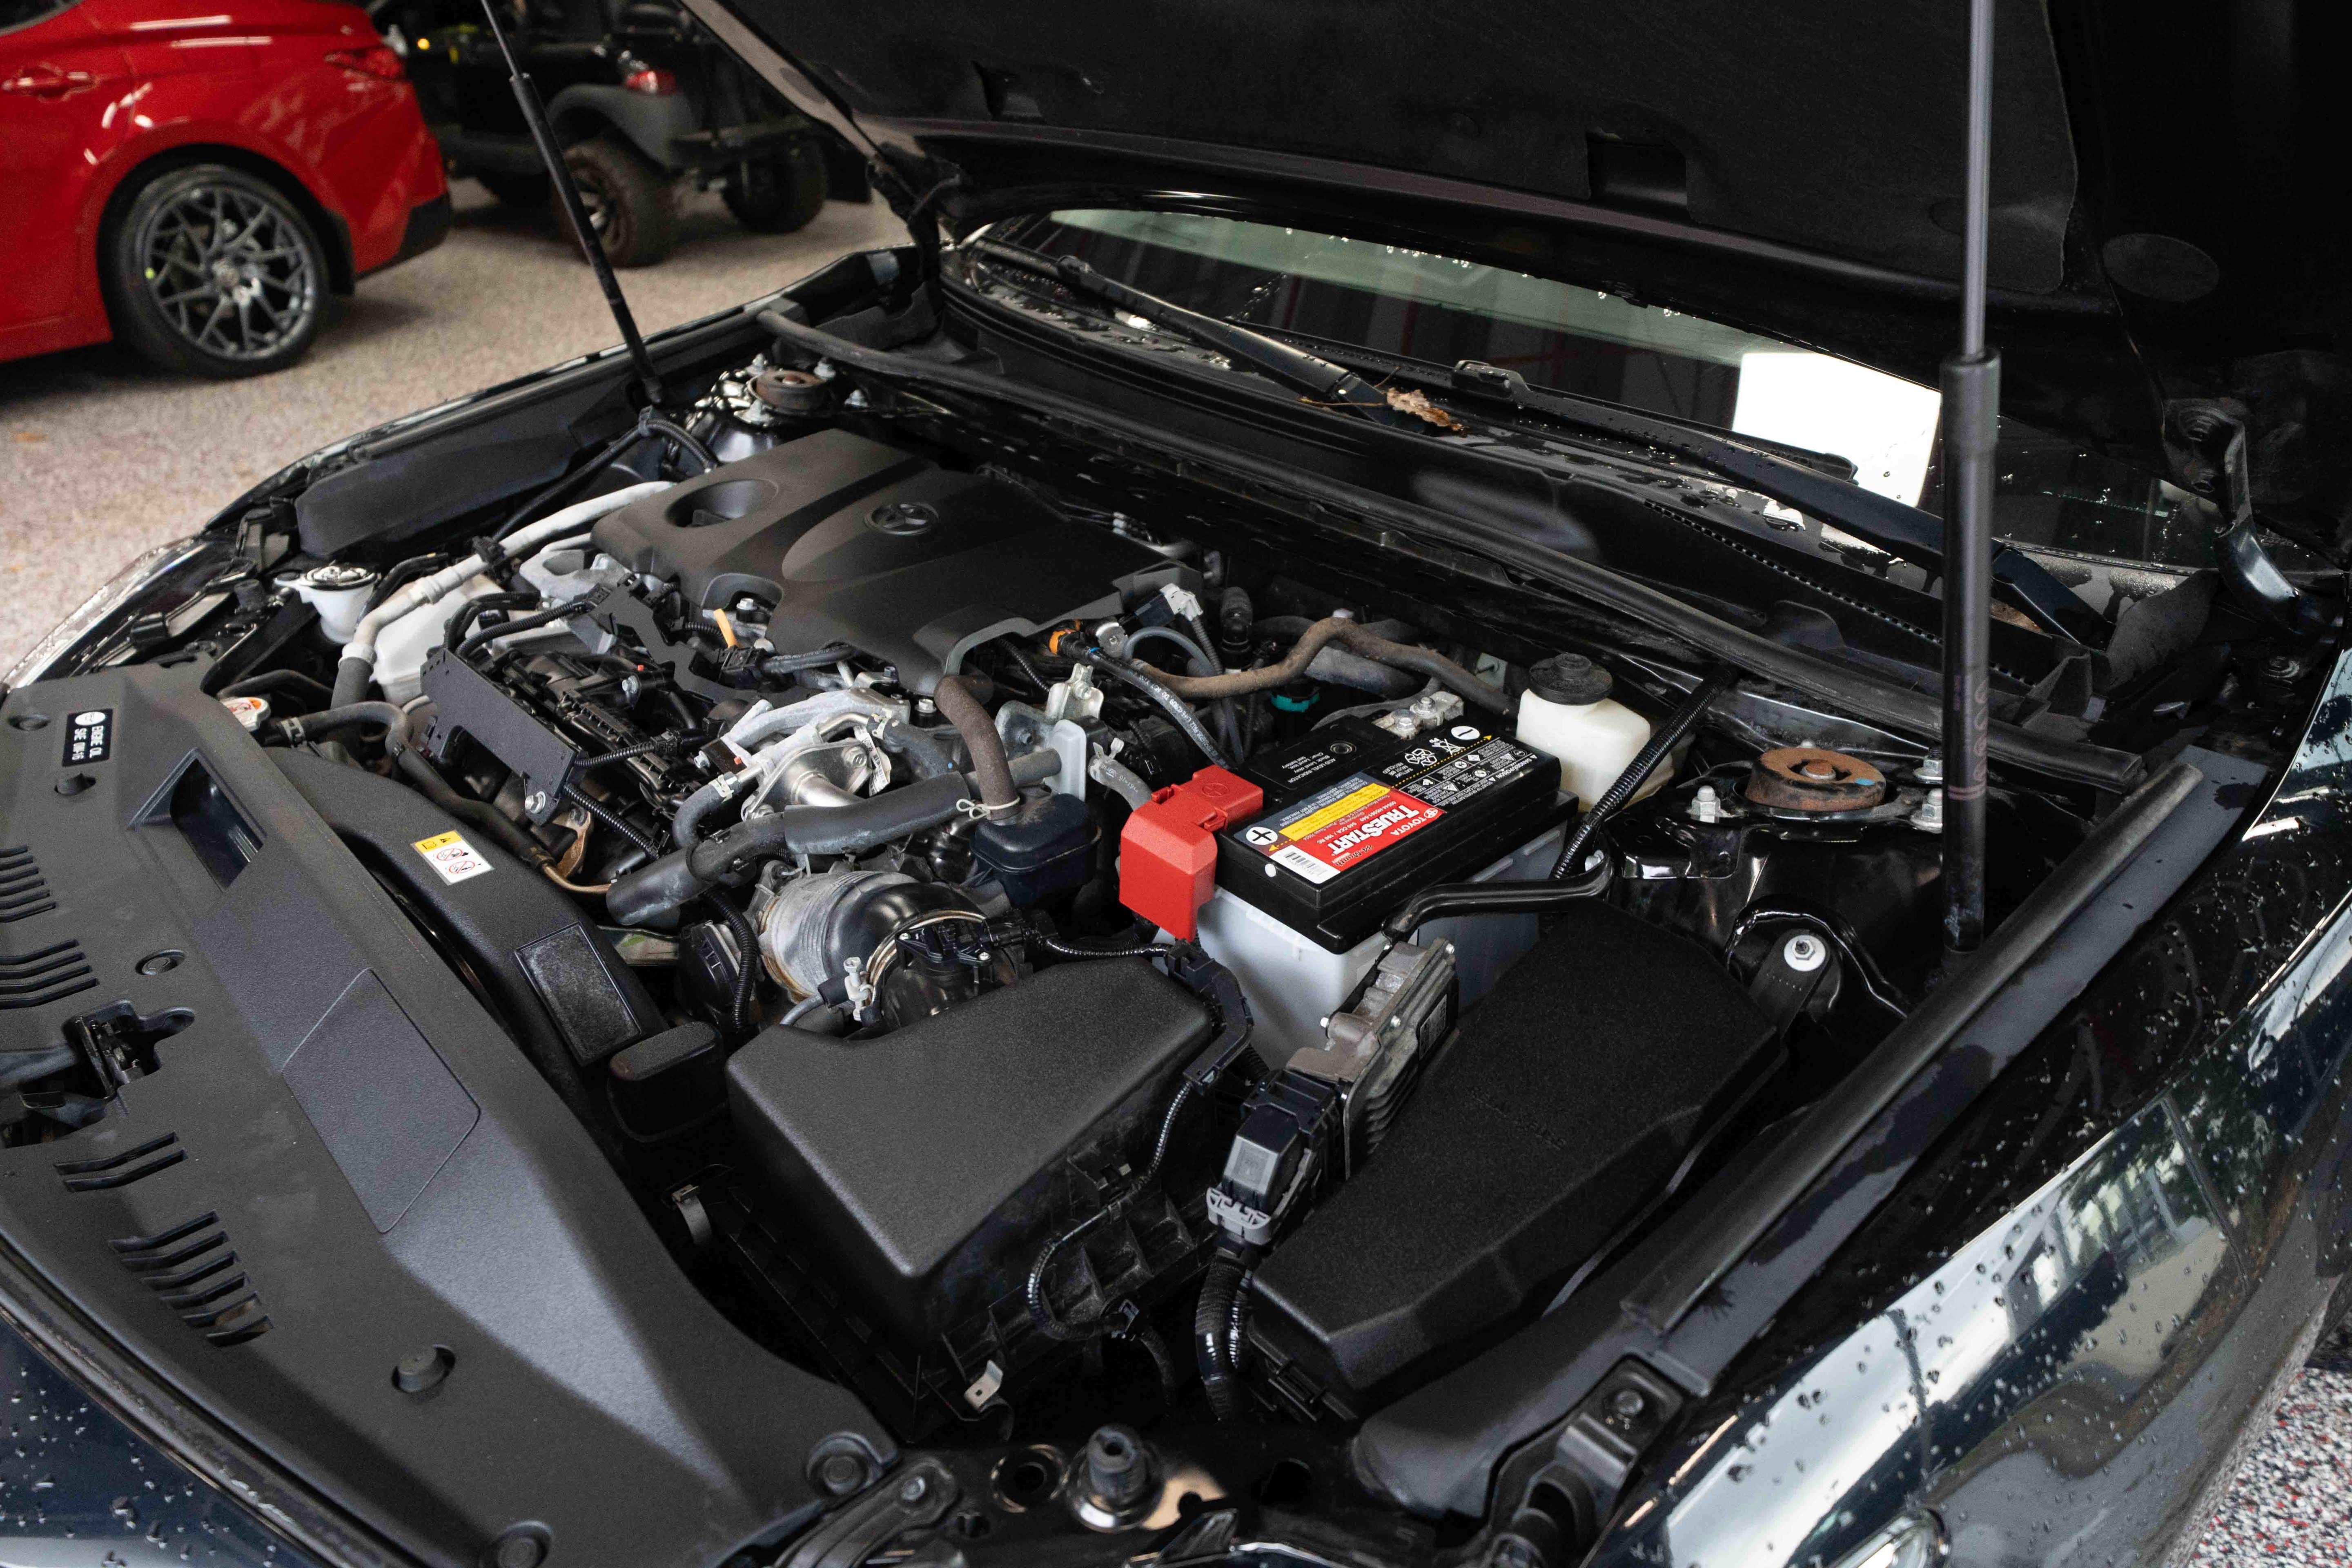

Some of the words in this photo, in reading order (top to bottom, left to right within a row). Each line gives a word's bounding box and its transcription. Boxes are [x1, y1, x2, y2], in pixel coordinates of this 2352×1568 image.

[1288, 770, 1312, 782] INDICATOR
[1328, 806, 1420, 855] TRUESTART
[1391, 817, 1426, 835] TOYOTA
